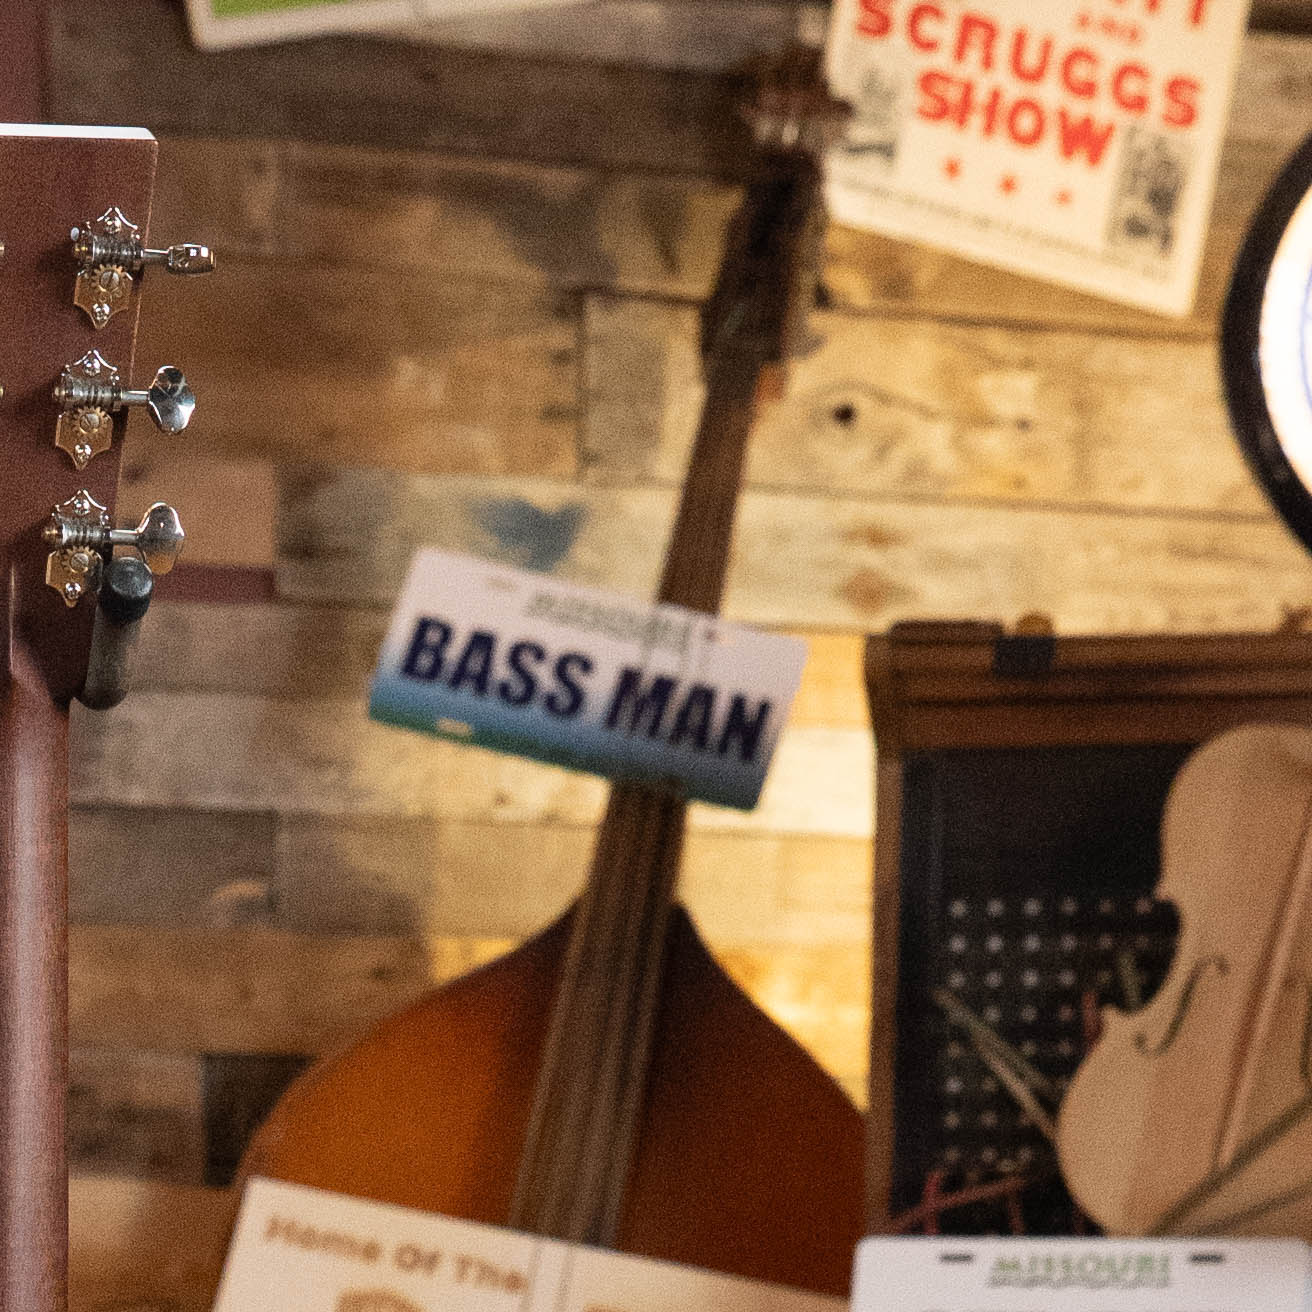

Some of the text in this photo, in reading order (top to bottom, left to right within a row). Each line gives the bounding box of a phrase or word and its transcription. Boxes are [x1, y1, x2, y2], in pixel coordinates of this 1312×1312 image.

[856, 0, 1201, 128] SCRUGGS
[917, 70, 1116, 168] SHOW
[399, 616, 594, 719] BASS
[605, 667, 773, 761] MAN
[454, 1252, 530, 1293] The
